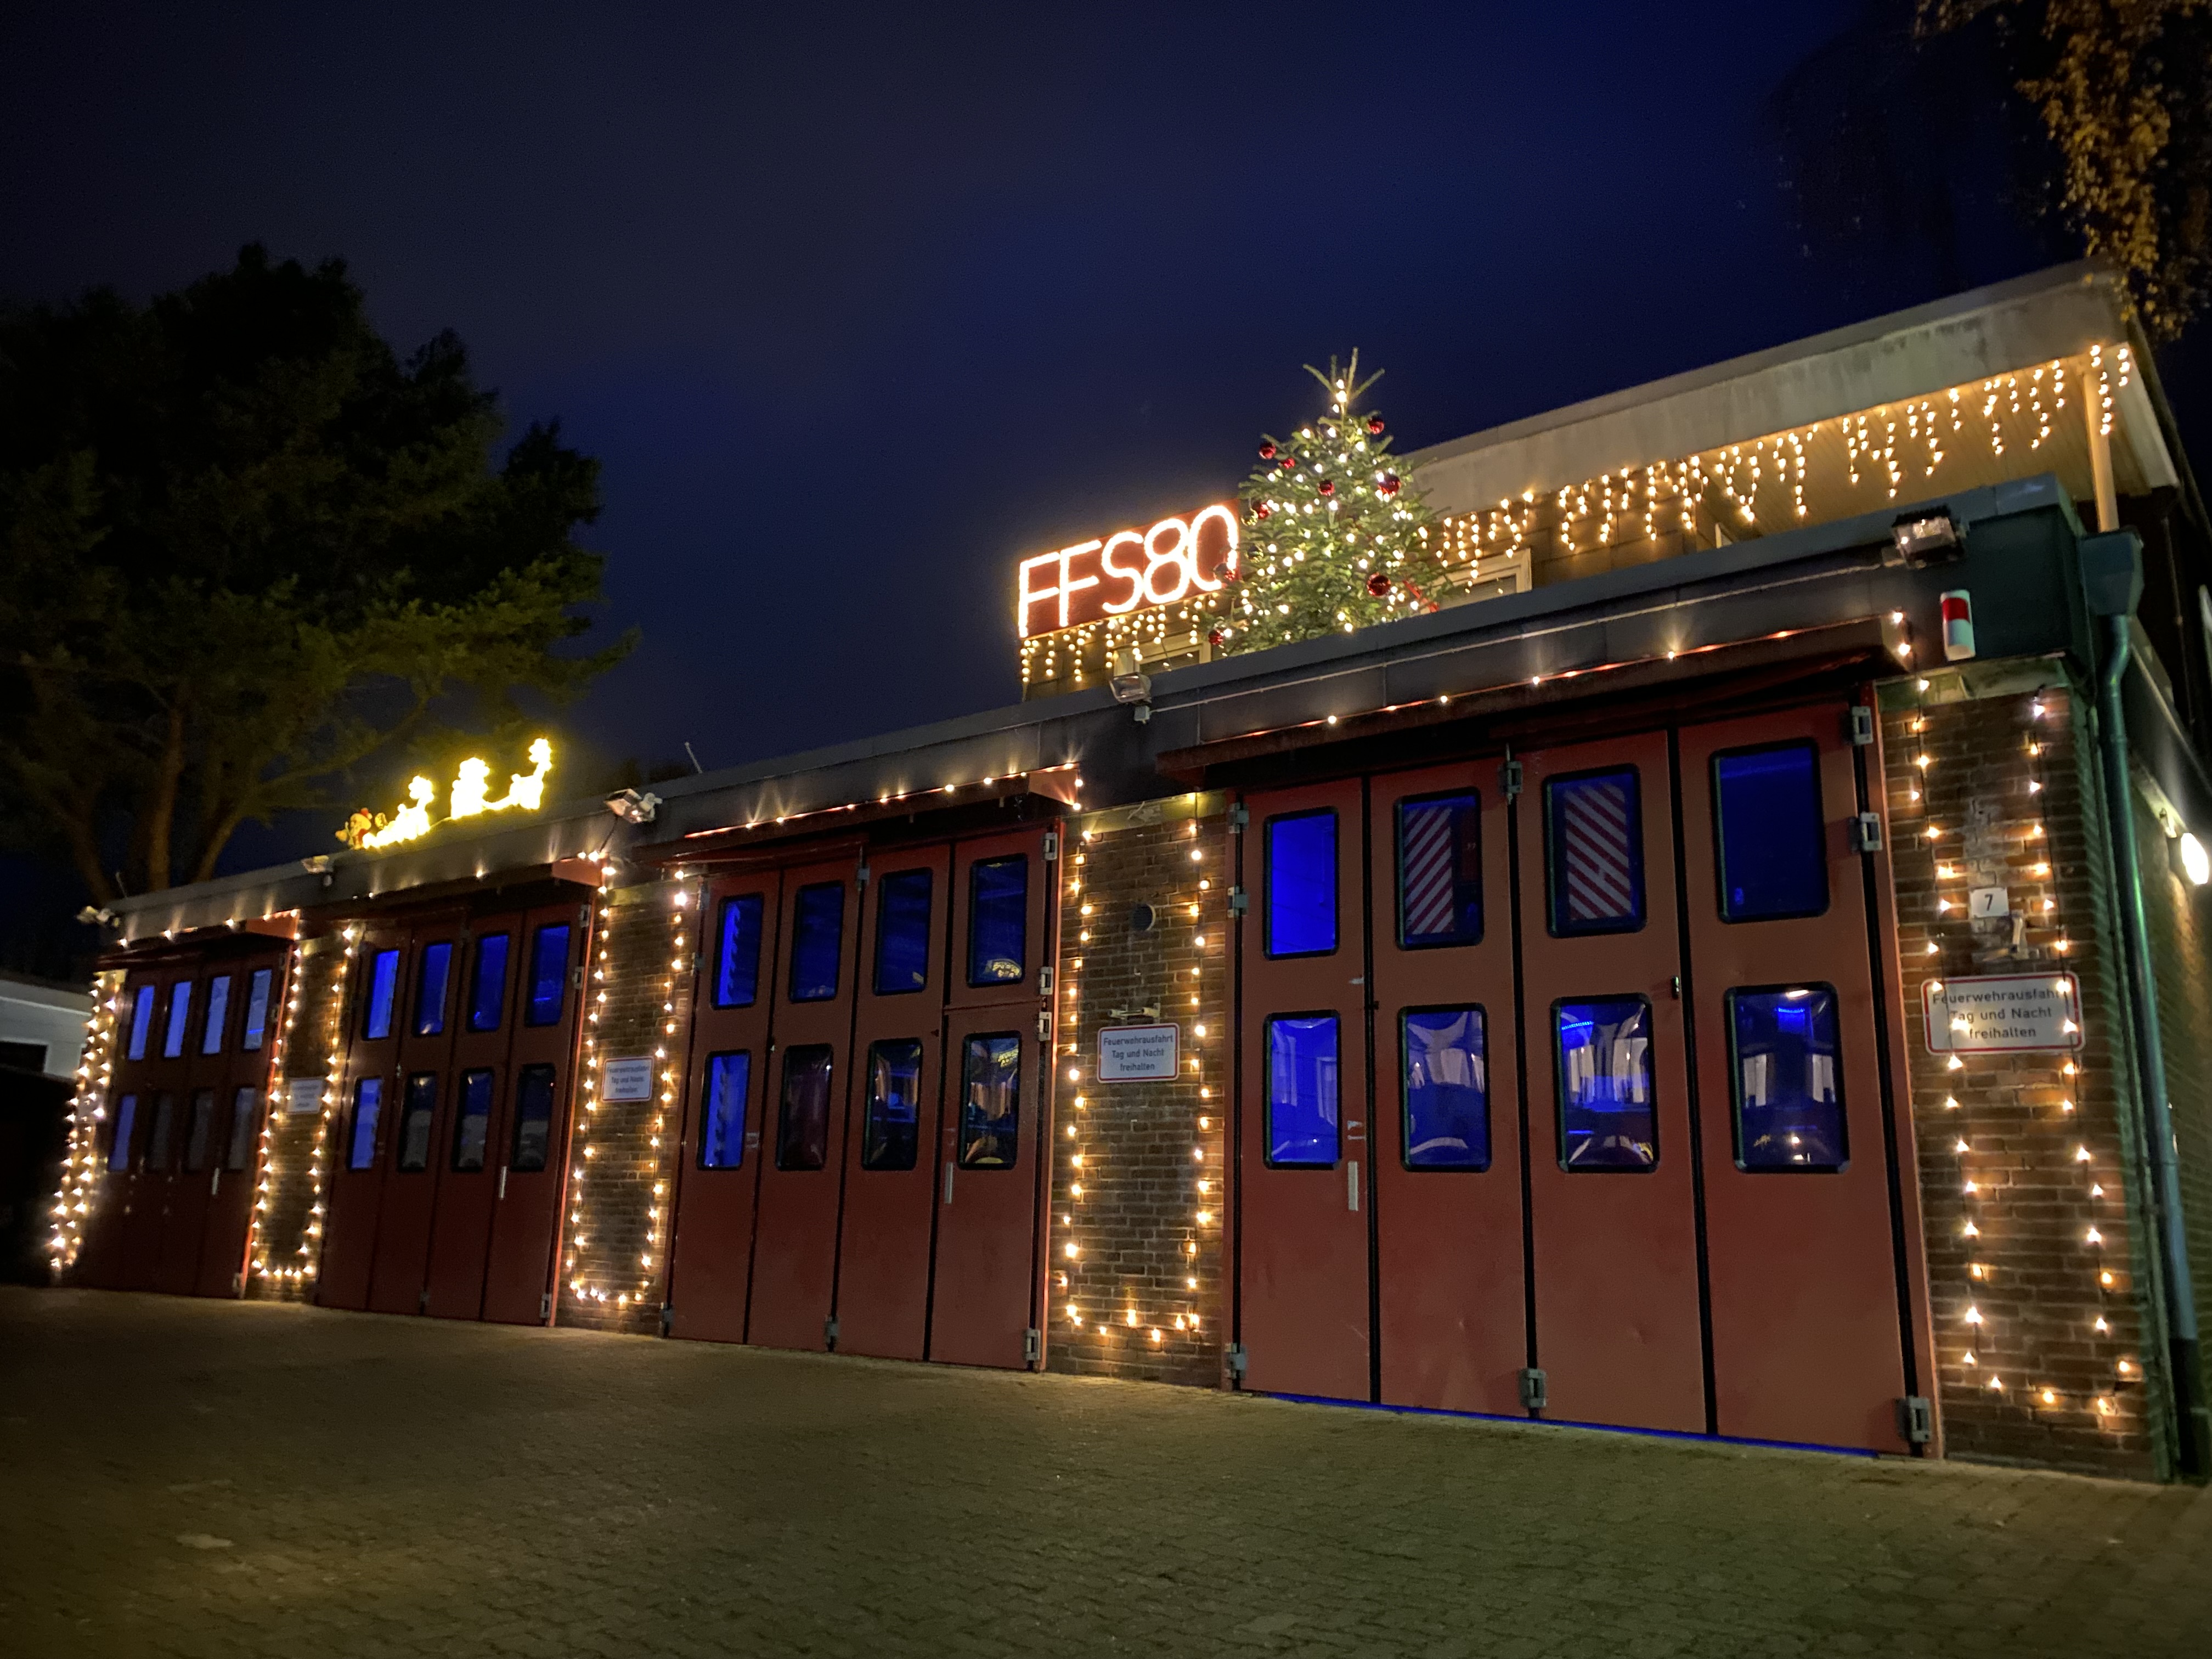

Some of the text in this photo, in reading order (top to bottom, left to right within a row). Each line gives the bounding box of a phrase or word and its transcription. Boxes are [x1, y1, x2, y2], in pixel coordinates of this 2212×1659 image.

[1018, 505, 1238, 638] FFS80
[1984, 893, 1994, 911] 7
[1932, 988, 2061, 1004] Feuerwehrausfahr
[1950, 1006, 2052, 1024] Tag und Nacht
[1103, 1034, 1173, 1046] Feuerwehrausfahrt
[1969, 1027, 2036, 1039] freihalten
[1112, 1048, 1164, 1060] Tag und Nacht
[1120, 1063, 1155, 1071] freihalten
